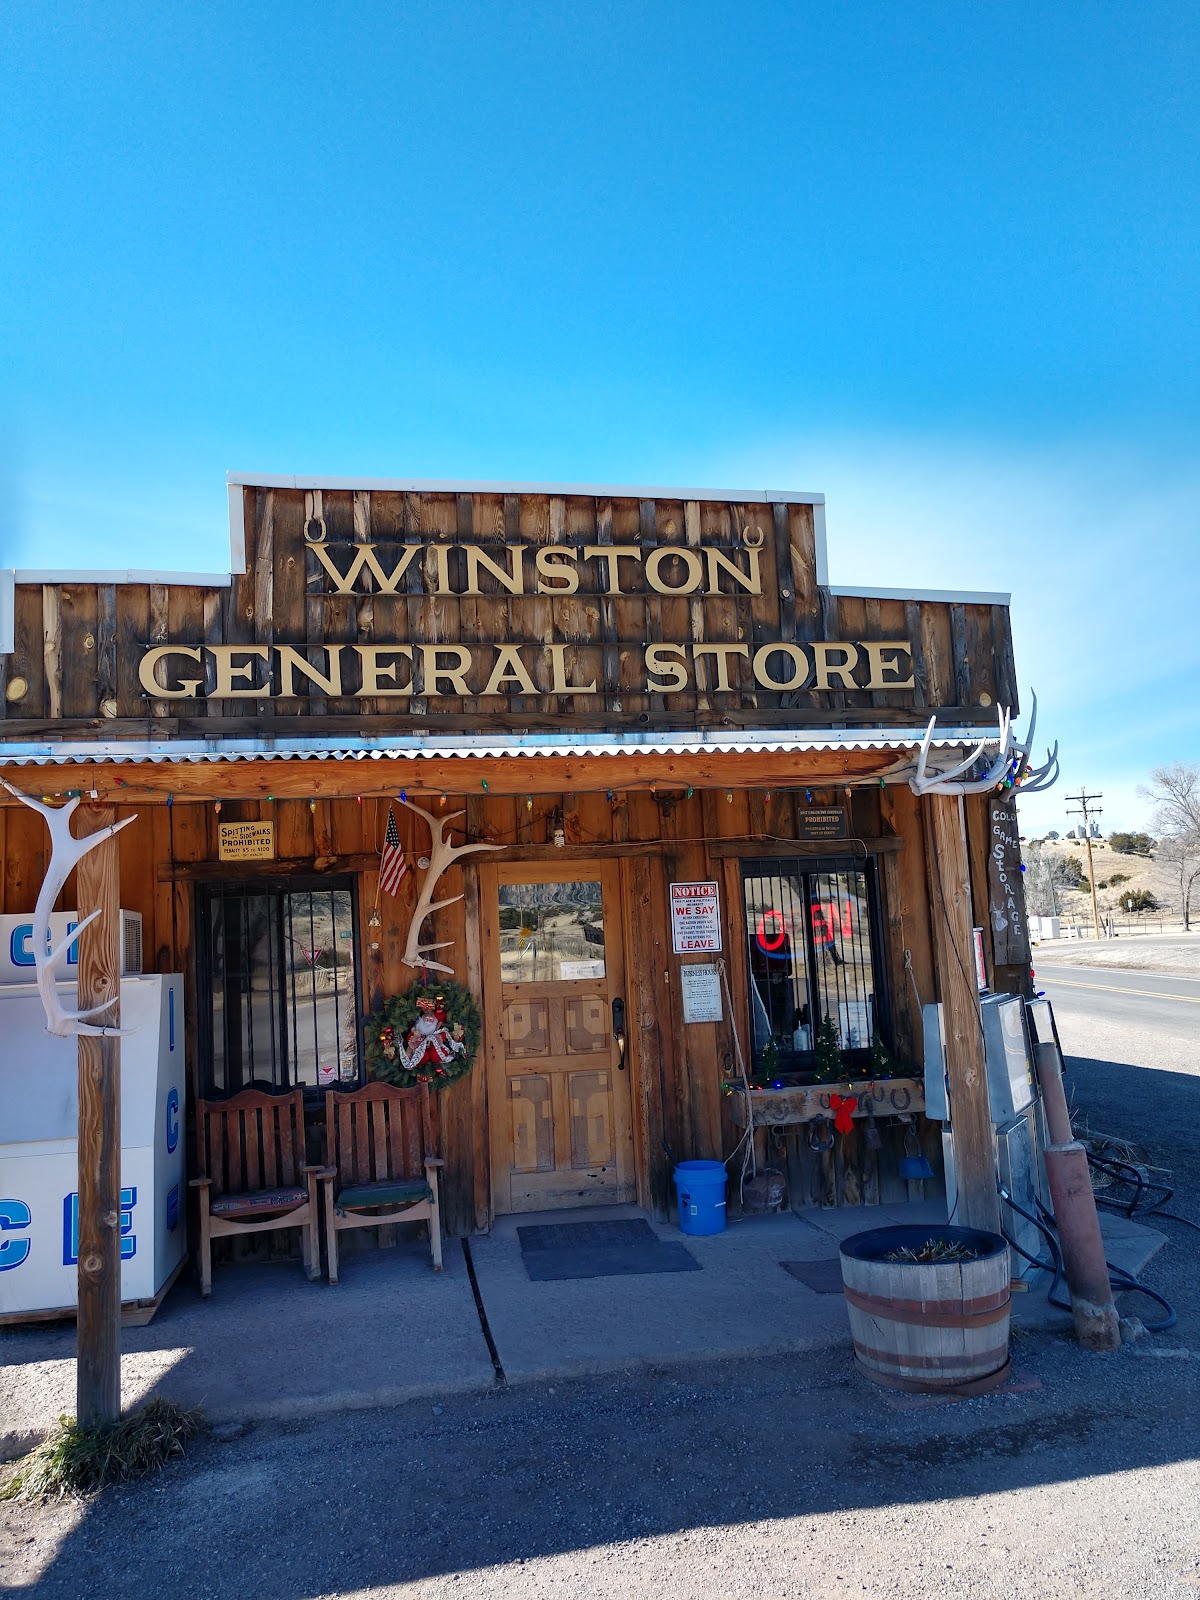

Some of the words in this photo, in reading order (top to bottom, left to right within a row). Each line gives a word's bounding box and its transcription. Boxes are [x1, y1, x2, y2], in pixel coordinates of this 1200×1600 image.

[304, 543, 764, 595] WINSTON
[139, 644, 597, 697] GENERAL
[644, 641, 915, 693] STORE
[221, 826, 254, 837] SPITTING
[240, 828, 271, 839] SIDEWALKS
[674, 886, 714, 896] NOTICE
[676, 906, 692, 916] WE
[695, 905, 715, 915] SAY
[757, 899, 853, 951] OEN
[681, 940, 714, 948] LEAVE
